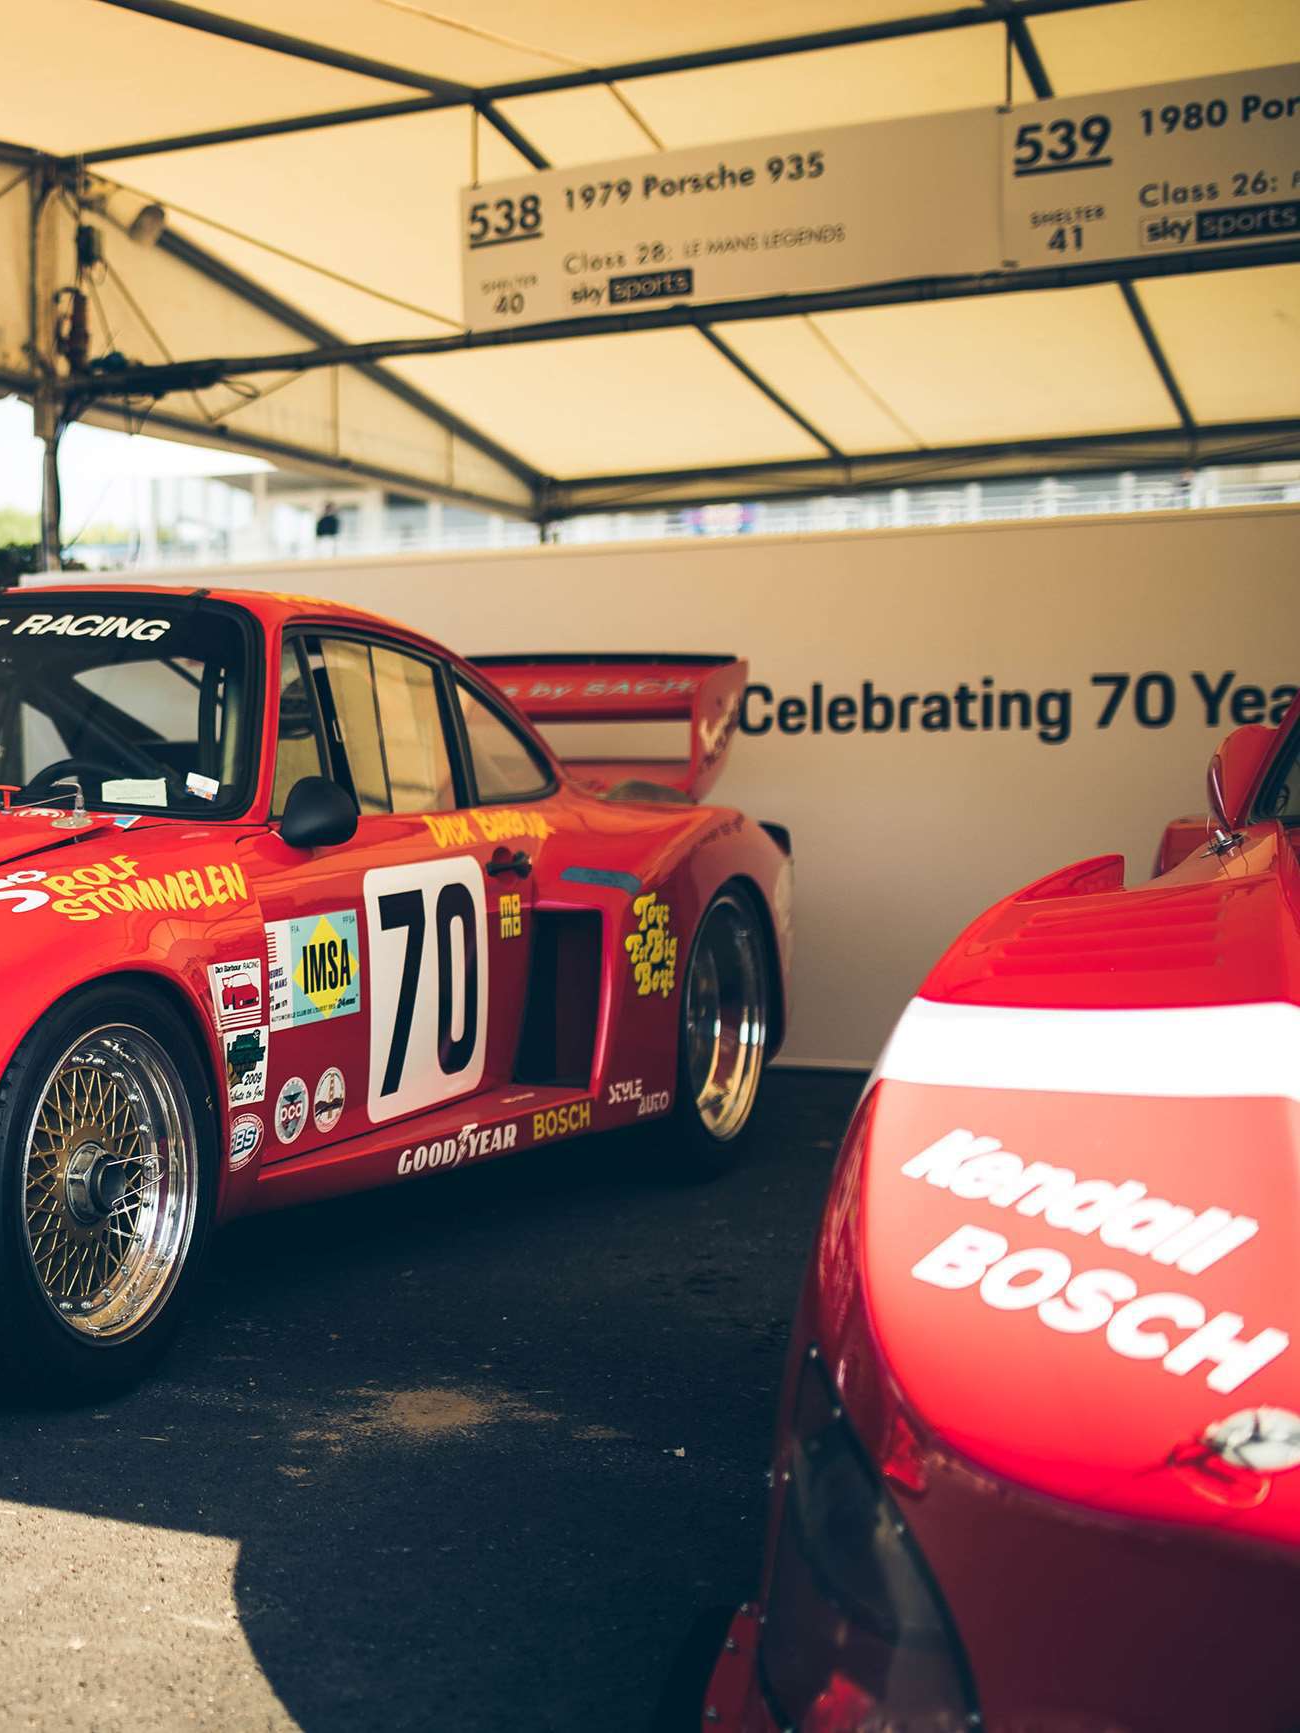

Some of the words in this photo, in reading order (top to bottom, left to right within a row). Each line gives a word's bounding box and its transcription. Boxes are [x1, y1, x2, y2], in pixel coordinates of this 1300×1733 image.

[1139, 98, 1228, 137] 1980
[1013, 115, 1112, 168] 539
[563, 179, 632, 212] 1979
[643, 162, 756, 200] Porsche
[766, 150, 826, 182] 935
[1138, 180, 1220, 208] Class
[1232, 169, 1278, 198] 26:
[469, 194, 542, 241] 538
[1030, 205, 1105, 229] SHELTER
[1147, 215, 1193, 243] sky
[1202, 207, 1297, 239] sports
[564, 249, 626, 275] Class
[683, 240, 701, 258] LE
[707, 233, 760, 255] MANS
[764, 223, 847, 250] LEGENDS
[1047, 225, 1083, 251] 41
[495, 292, 524, 315] 40
[571, 282, 608, 305] sky
[614, 271, 690, 302] sports
[12, 613, 172, 643] RACING
[582, 677, 699, 697] SACH
[738, 674, 1073, 745] Celebrating
[1091, 671, 1176, 728] 70
[42, 855, 140, 898] ROLF
[50, 862, 249, 921] STOMMELEN
[302, 938, 352, 995] IMSA
[377, 882, 478, 1098] 70
[244, 1071, 263, 1086] 2009
[608, 1078, 643, 1105] STYLE
[533, 1101, 591, 1141] BOSCH
[397, 1122, 518, 1176] GOODYEAR
[900, 1128, 1259, 1276] Kendall
[910, 1223, 1290, 1396] BOSCH
